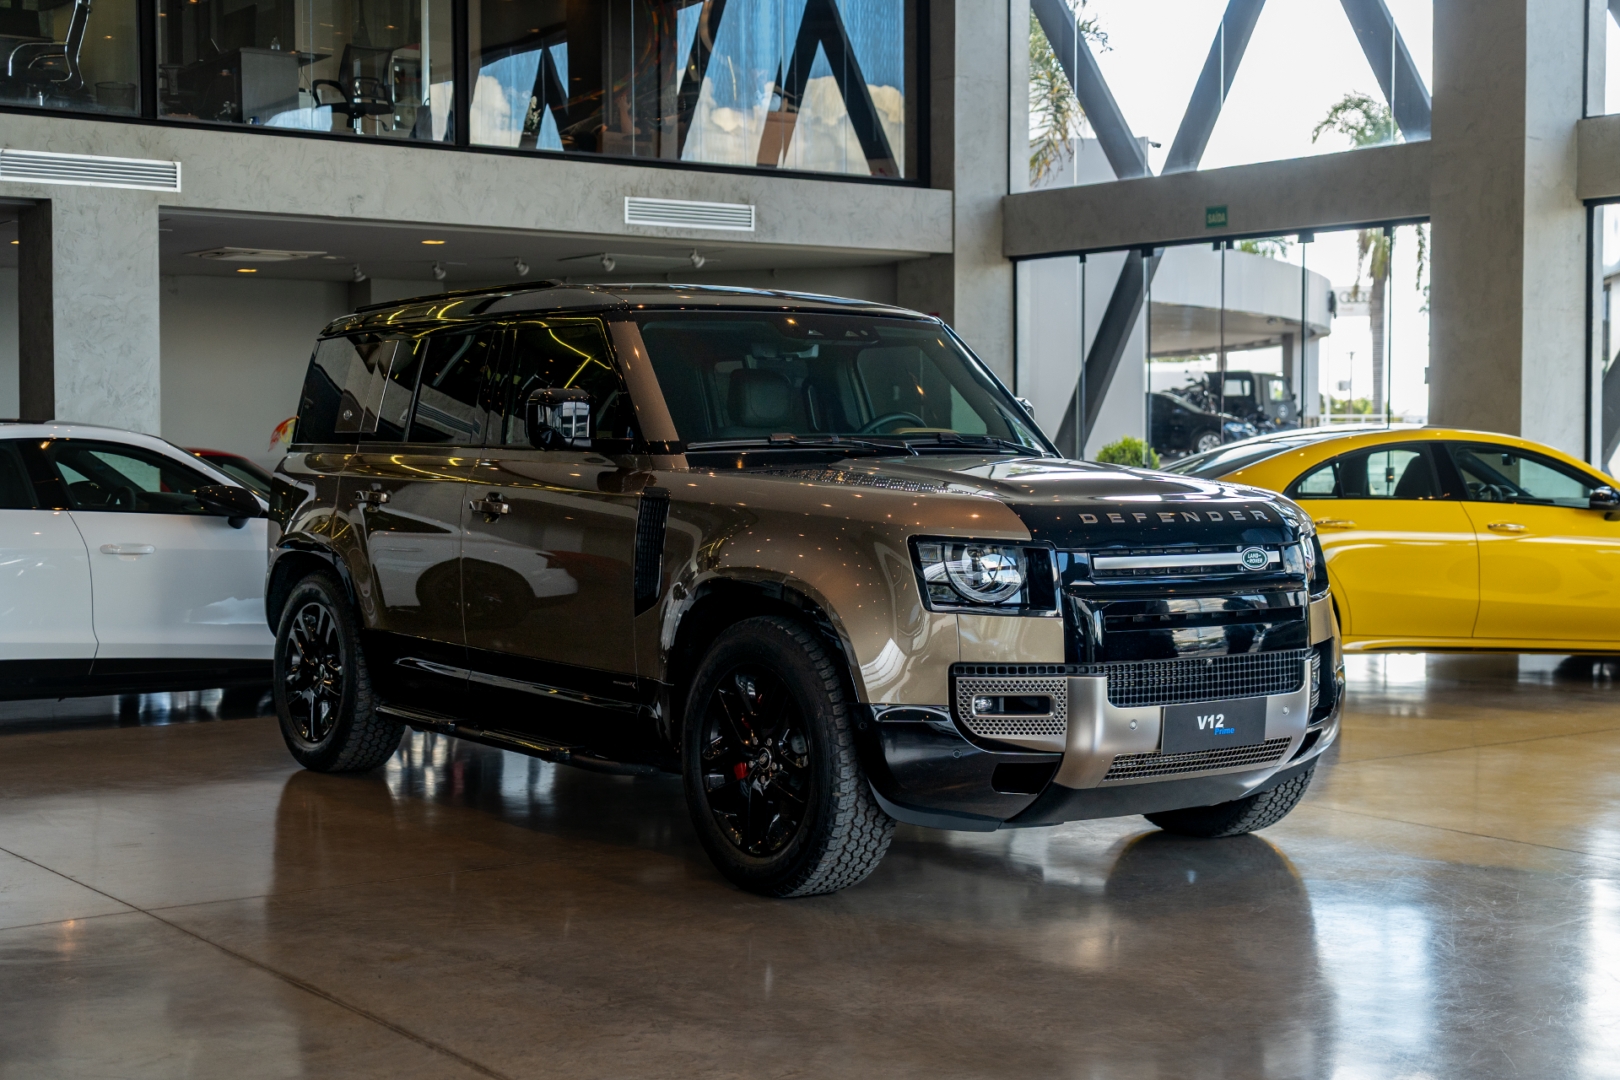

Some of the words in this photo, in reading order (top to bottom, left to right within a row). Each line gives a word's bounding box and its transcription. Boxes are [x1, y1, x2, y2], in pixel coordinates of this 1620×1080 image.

[1078, 510, 1269, 524] DEFENDER
[1197, 713, 1225, 730] V12
[1214, 727, 1235, 735] Prime
